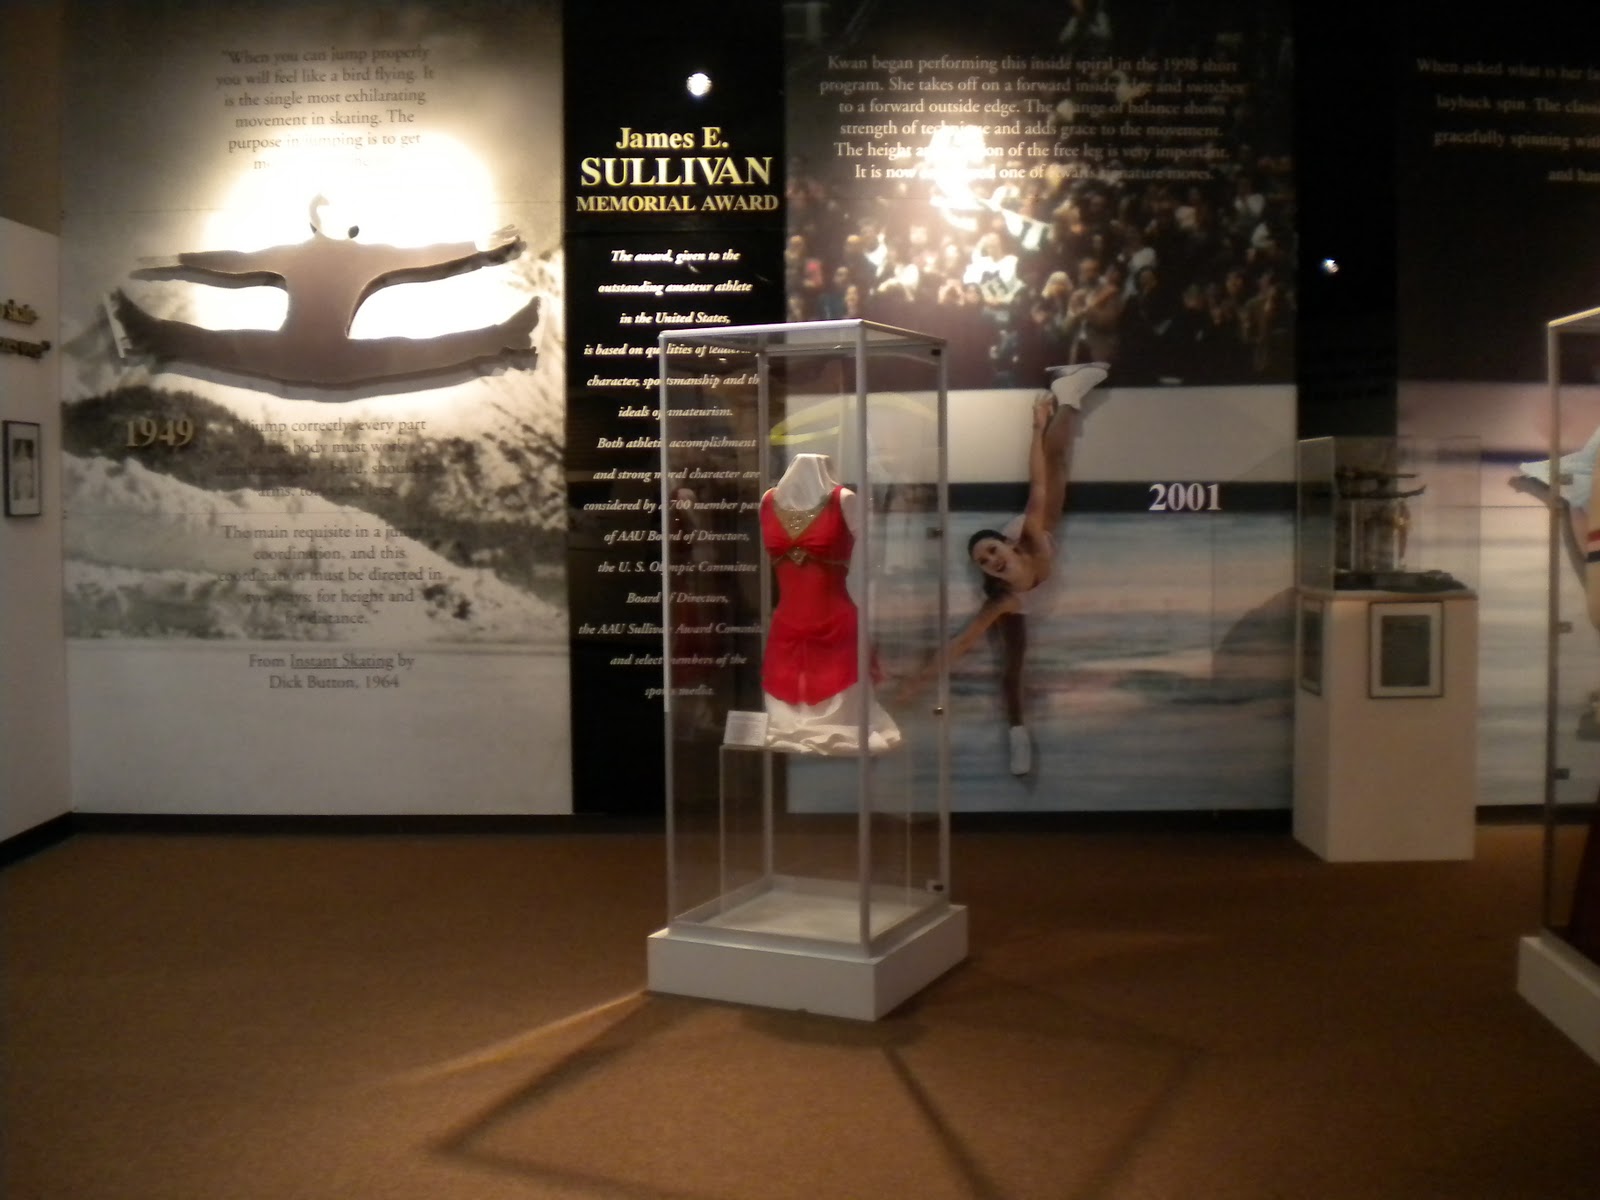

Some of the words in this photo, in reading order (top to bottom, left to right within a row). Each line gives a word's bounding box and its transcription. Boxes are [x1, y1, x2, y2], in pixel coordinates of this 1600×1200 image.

[273, 51, 299, 66] you
[303, 51, 327, 62] can
[331, 47, 368, 64] jump
[372, 44, 430, 63] properly
[828, 55, 867, 70] Kwan
[872, 54, 913, 74] began
[918, 54, 998, 74] performing
[1002, 55, 1026, 70] this
[1031, 55, 1071, 70] inside
[1075, 56, 1113, 74] spiral
[1117, 57, 1132, 70] in
[1136, 57, 1158, 71] the
[1164, 57, 1198, 71] 1998
[1202, 57, 1237, 72] short
[1416, 57, 1458, 73] When
[1508, 61, 1540, 77] what
[215, 75, 241, 90] you
[245, 70, 270, 85] will
[274, 68, 297, 84] feel
[302, 68, 327, 83] like
[342, 67, 371, 82] bird
[375, 66, 418, 84] flying.
[423, 65, 435, 80] It
[820, 80, 884, 96] program.
[889, 77, 914, 91] She
[919, 77, 953, 91] takes
[957, 76, 980, 91] off
[981, 81, 1000, 91] on
[1004, 82, 1012, 91] a
[1017, 77, 1071, 91] forward
[1156, 79, 1182, 93] and
[224, 93, 235, 107] is
[238, 92, 260, 106] the
[264, 91, 302, 109] single
[307, 92, 341, 105] most
[344, 88, 427, 105] exhilarating
[839, 102, 853, 113] to
[857, 104, 865, 113] a
[870, 98, 924, 113] forward
[929, 98, 980, 113] outside
[984, 99, 1020, 117] edge.
[1024, 99, 1053, 113] The
[1128, 100, 1180, 114] balance
[1184, 100, 1225, 115] shows
[1436, 94, 1491, 111] layback
[1534, 97, 1561, 112] The
[235, 115, 307, 128] movement
[311, 112, 324, 125] in
[329, 110, 382, 129] skating.
[386, 108, 415, 123] The
[615, 127, 695, 150] James
[702, 126, 729, 149] E.
[840, 120, 898, 138] strength
[902, 120, 919, 134] of
[994, 120, 1020, 134] and
[1025, 120, 1056, 135] adds
[1060, 127, 1097, 140] grace
[1101, 126, 1115, 135] to
[1120, 121, 1143, 136] the
[1146, 126, 1224, 136] movement.
[228, 138, 282, 153] purpose
[367, 132, 378, 145] is
[382, 133, 396, 145] to
[400, 135, 421, 152] get
[1433, 128, 1505, 148] gracefully
[1510, 132, 1570, 151] spinning
[834, 142, 863, 157] The
[867, 142, 912, 160] height
[1008, 142, 1025, 157] of
[1027, 142, 1049, 157] the
[1054, 141, 1080, 157] free
[1083, 142, 1104, 161] leg
[1108, 143, 1119, 157] is
[1122, 147, 1151, 161] very
[581, 157, 773, 187] SULLIVAN
[855, 164, 867, 178] It
[871, 165, 882, 178] is
[886, 168, 916, 178] now
[999, 169, 1026, 178] one
[1029, 163, 1045, 178] of
[576, 195, 696, 212] MEMORIAL
[701, 194, 780, 211] AWARD
[611, 250, 632, 262] The
[634, 250, 674, 263] award,
[675, 250, 706, 264] given
[708, 250, 719, 261] to
[722, 249, 741, 261] the
[598, 280, 664, 296] outstanding
[665, 282, 712, 292] amateur
[714, 280, 753, 291] athlete
[619, 313, 632, 324] in
[635, 313, 653, 324] the
[655, 312, 693, 324] United
[695, 312, 731, 325] States,
[584, 344, 593, 355] is
[595, 344, 626, 355] based
[628, 346, 643, 355] on
[695, 345, 707, 357] of
[586, 375, 640, 388] character,
[723, 373, 744, 385] and
[618, 407, 649, 418] ideals
[125, 417, 193, 448] 1949
[398, 420, 426, 434] part
[294, 438, 328, 456] body
[332, 442, 366, 453] must
[597, 437, 623, 449] Both
[668, 438, 757, 451] accomplishment
[593, 468, 616, 479] and
[617, 470, 652, 482] strong
[689, 468, 738, 479] character
[1149, 483, 1221, 511] 2001
[583, 499, 640, 511] considered
[643, 499, 656, 514] by
[669, 499, 691, 511] 700
[693, 499, 737, 511] member
[221, 525, 250, 539] The
[254, 526, 288, 538] main
[293, 525, 351, 543] requisite
[355, 525, 369, 538] in
[374, 528, 381, 538] a
[604, 531, 617, 545] of
[617, 531, 644, 542] AAU
[683, 530, 696, 545] of
[697, 530, 750, 542] Directors,
[350, 545, 376, 560] and
[380, 545, 407, 559] this
[348, 567, 364, 581] be
[368, 566, 424, 581] directed
[428, 567, 442, 581] in
[598, 562, 615, 573] the
[618, 562, 632, 573] U.
[634, 562, 645, 573] S.
[698, 561, 757, 573] Committee
[317, 588, 337, 603] for
[341, 588, 384, 607] height
[388, 588, 414, 602] and
[626, 592, 661, 603] Board
[578, 623, 597, 634] the
[598, 624, 626, 635] AAU
[674, 623, 713, 634] Award
[248, 653, 285, 668] From
[290, 652, 338, 669] Instant
[342, 652, 395, 672] Skating
[398, 652, 416, 672] by
[609, 654, 632, 665] and
[716, 654, 727, 668] of
[730, 655, 747, 665] the
[269, 674, 302, 689] Dick
[307, 674, 359, 691] Button,
[365, 675, 400, 689] 1964
